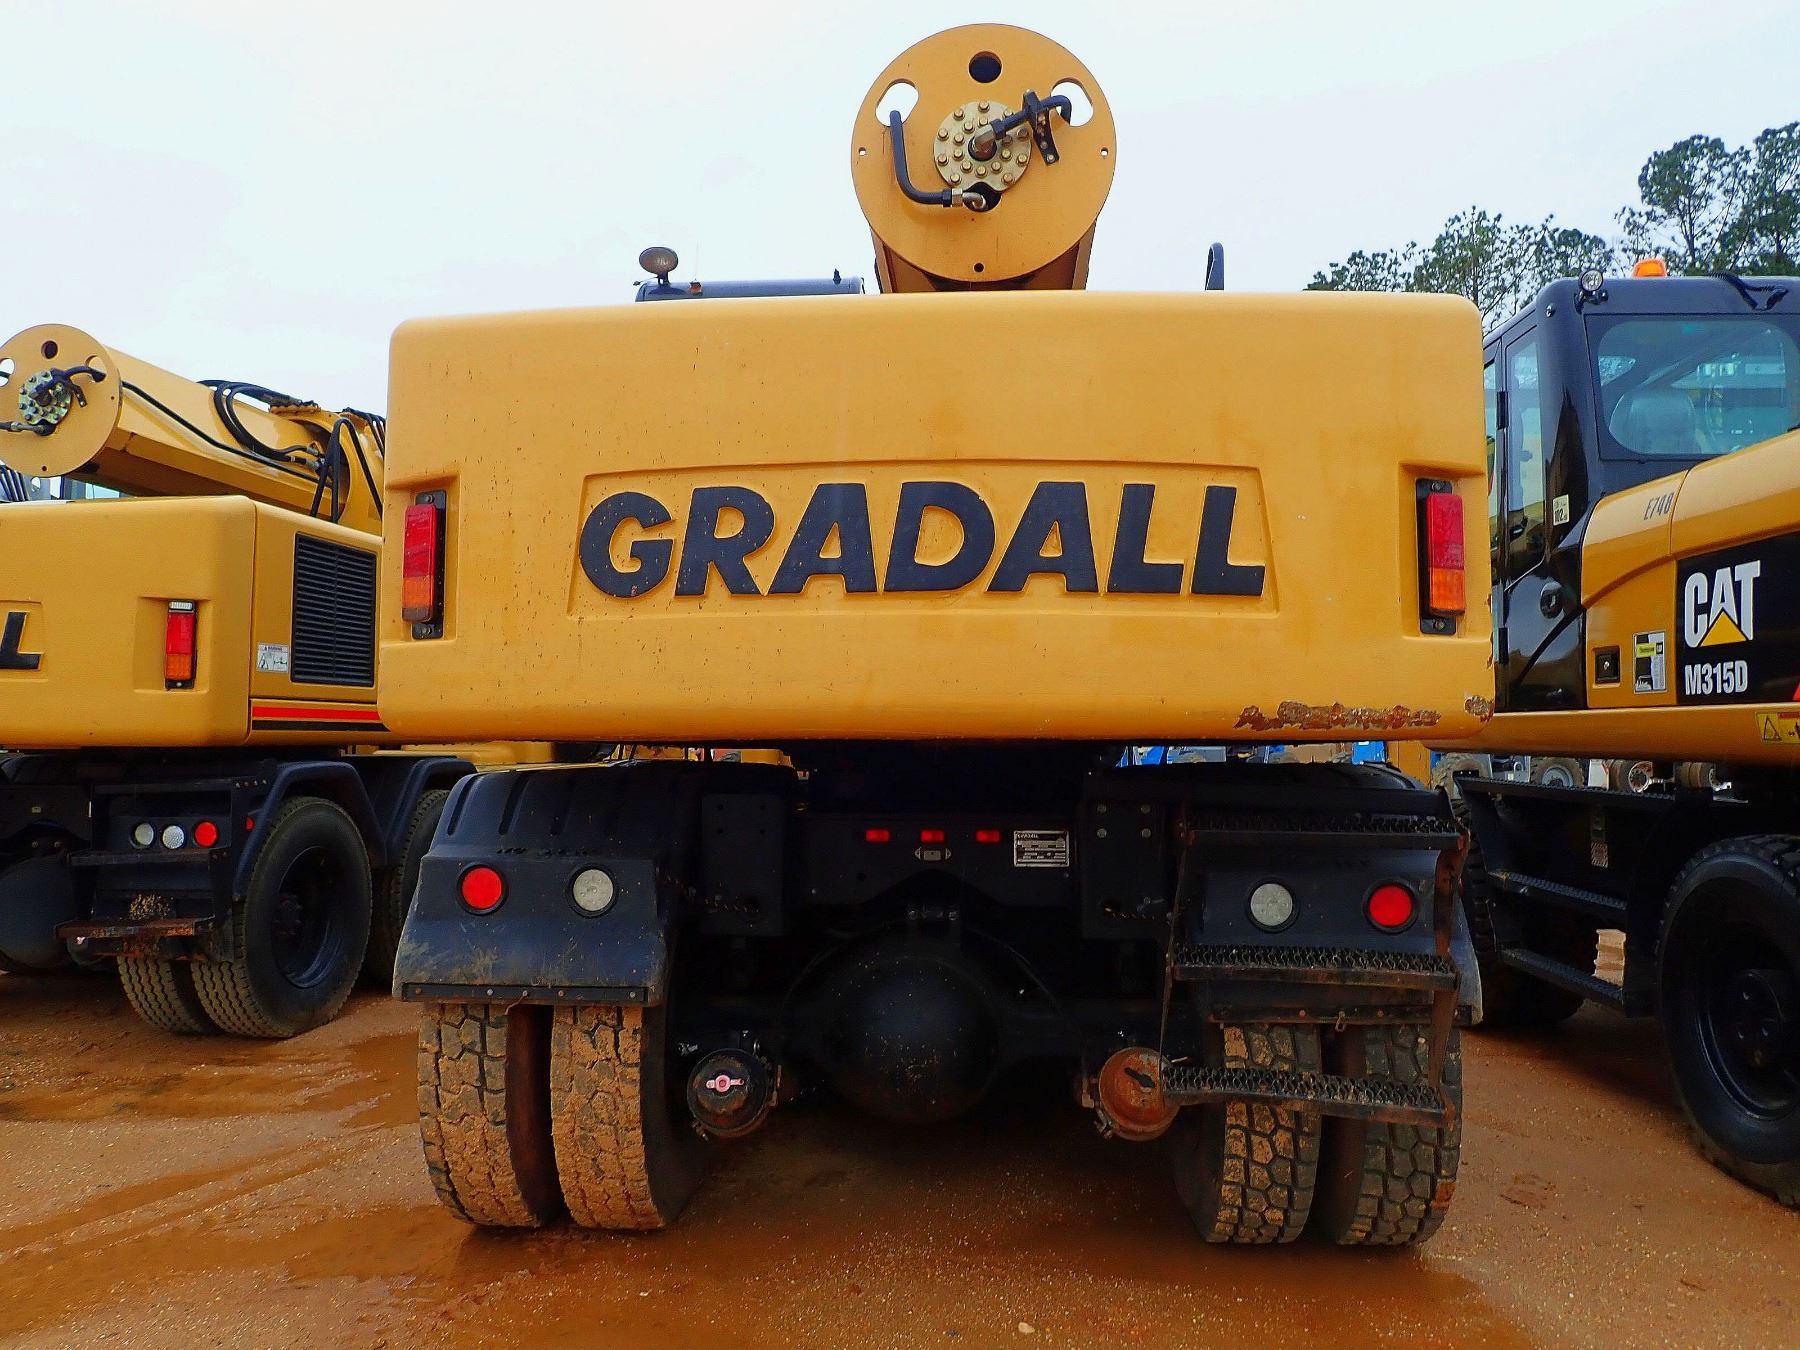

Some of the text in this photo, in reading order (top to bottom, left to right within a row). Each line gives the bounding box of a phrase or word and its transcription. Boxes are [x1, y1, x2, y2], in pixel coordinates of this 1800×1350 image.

[579, 481, 1265, 598] GRADALL
[1684, 560, 1760, 648] CAT
[1684, 660, 1748, 695] M315D
